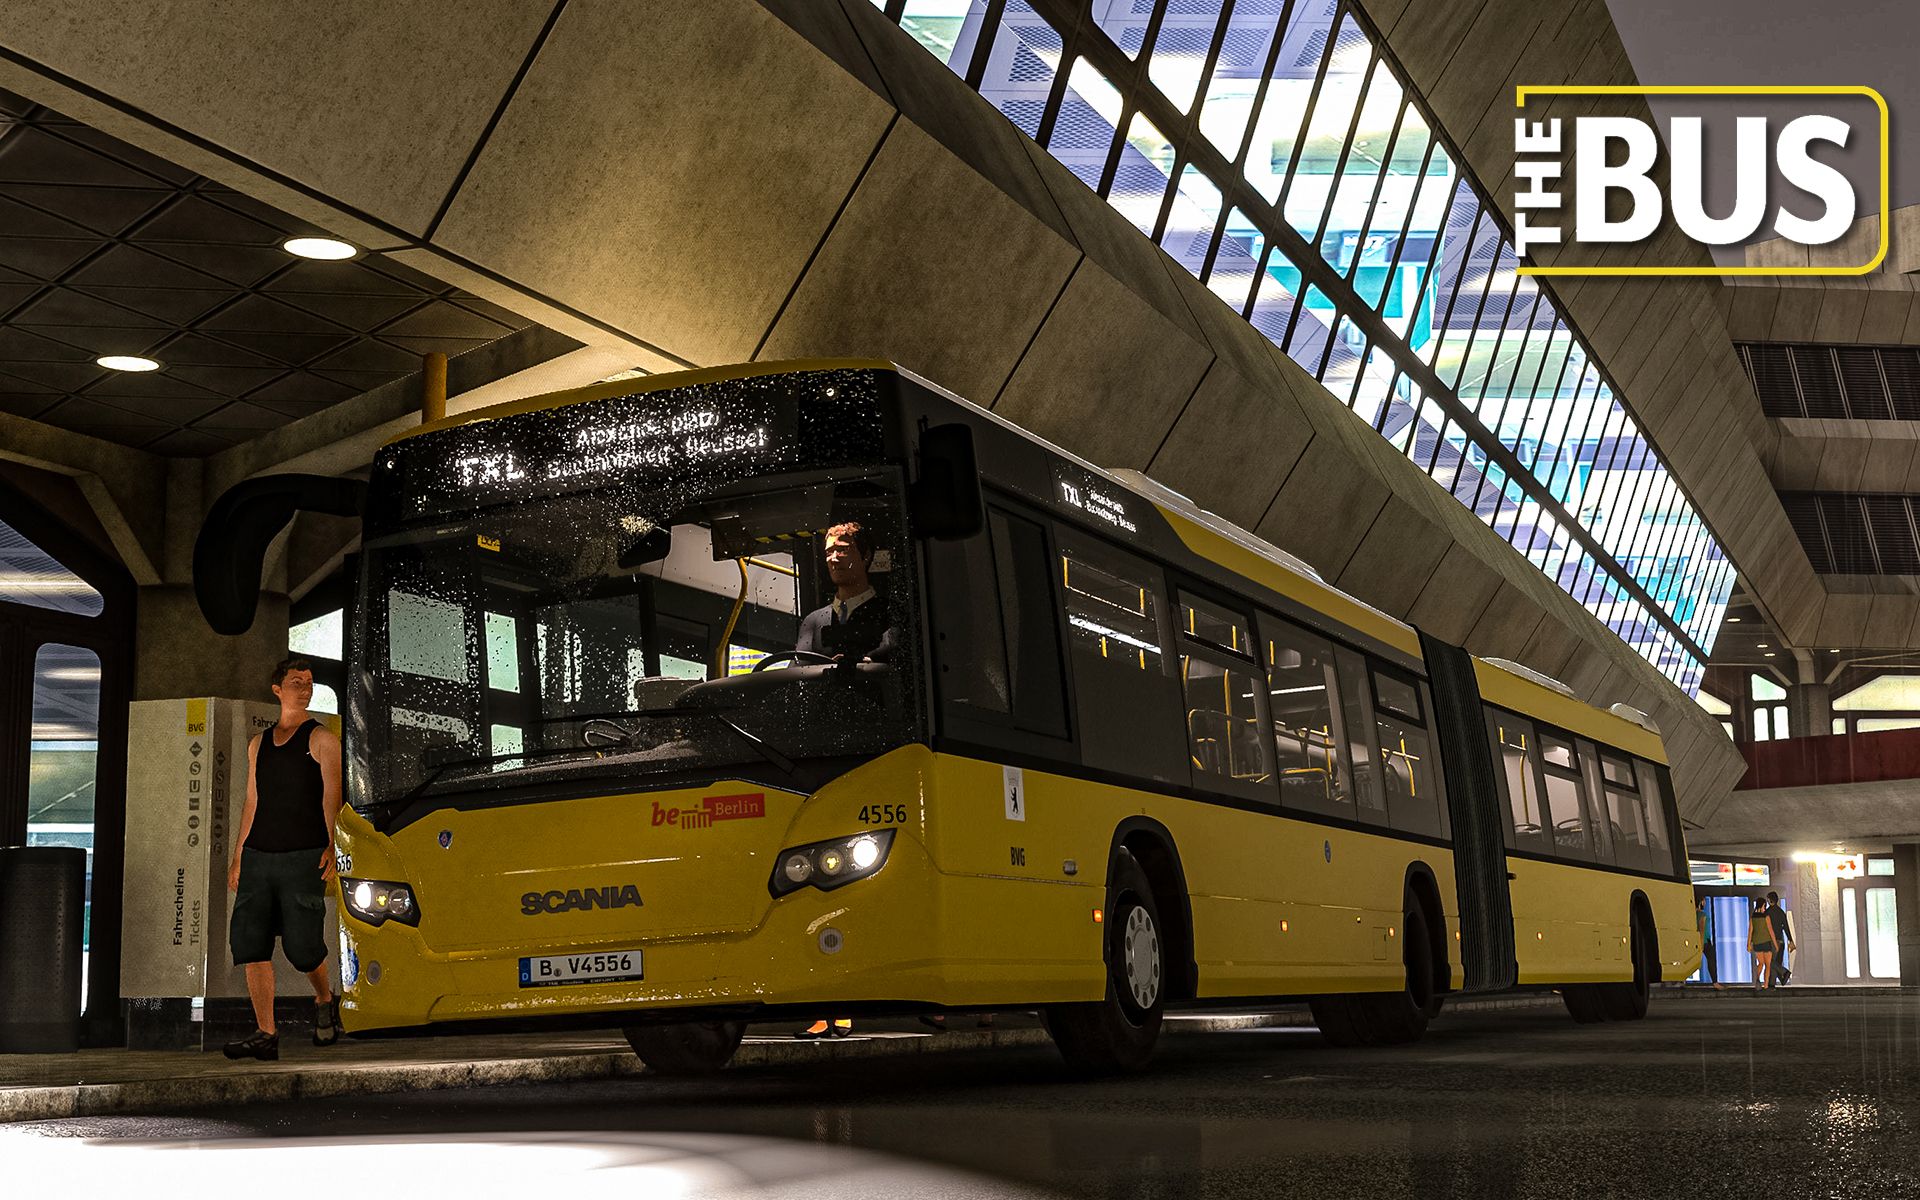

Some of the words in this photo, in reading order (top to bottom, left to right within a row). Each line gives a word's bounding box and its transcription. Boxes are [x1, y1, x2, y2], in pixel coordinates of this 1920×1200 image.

[188, 723, 204, 733] BVG
[715, 800, 759, 816] Berlin
[858, 804, 907, 825] 4556
[1010, 846, 1025, 867] BVG
[173, 867, 185, 946] Fahrscheine
[520, 884, 644, 915] SCANIA
[190, 900, 200, 946] Tickets
[521, 972, 529, 981] D
[568, 954, 632, 975] V4556
